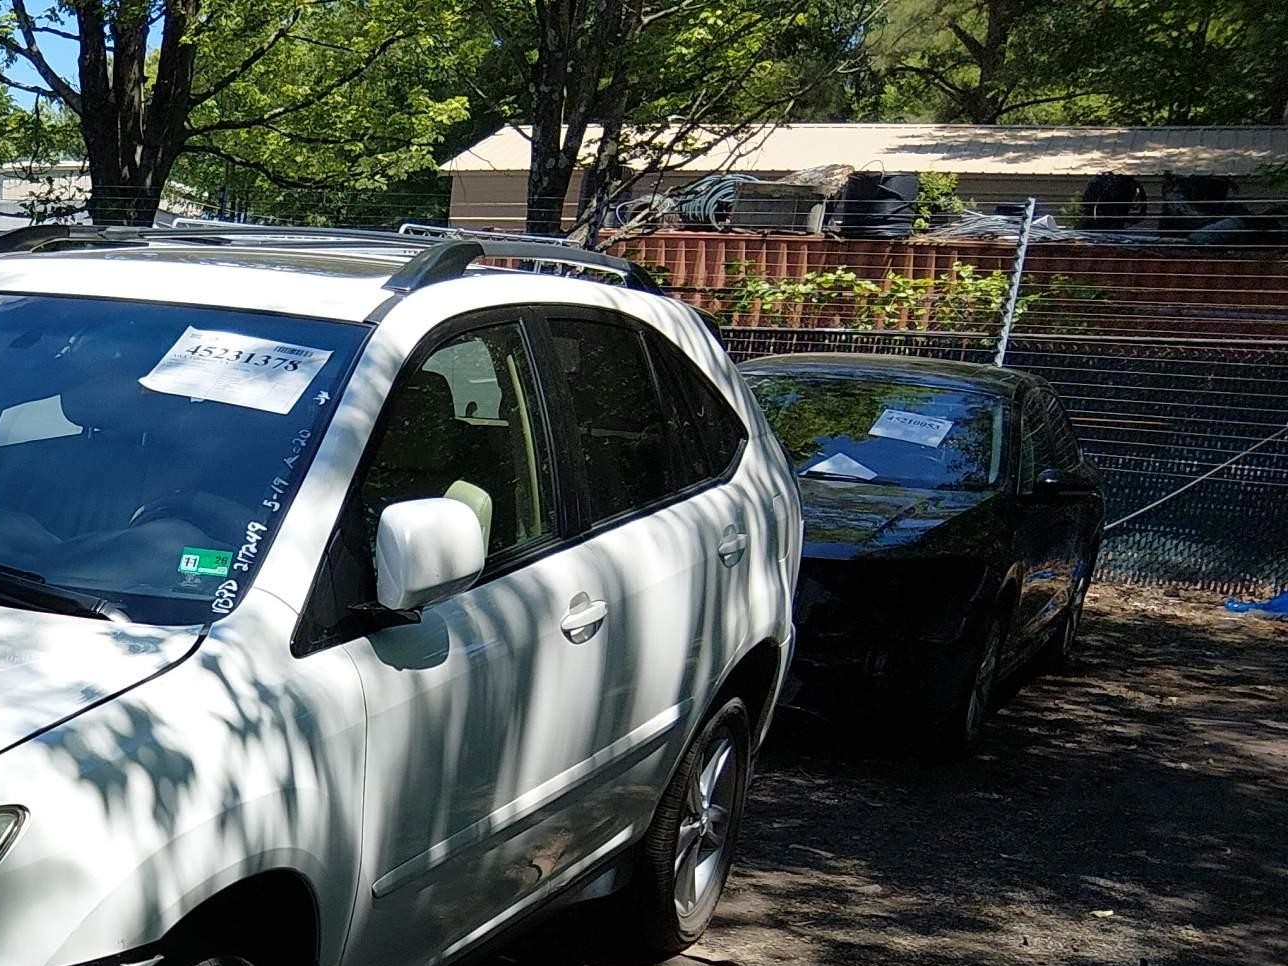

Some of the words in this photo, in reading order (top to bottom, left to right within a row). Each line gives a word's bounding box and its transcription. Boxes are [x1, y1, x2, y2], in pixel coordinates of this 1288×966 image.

[186, 344, 300, 372] 45231378
[184, 556, 198, 568] 11
[214, 555, 228, 566] 26
